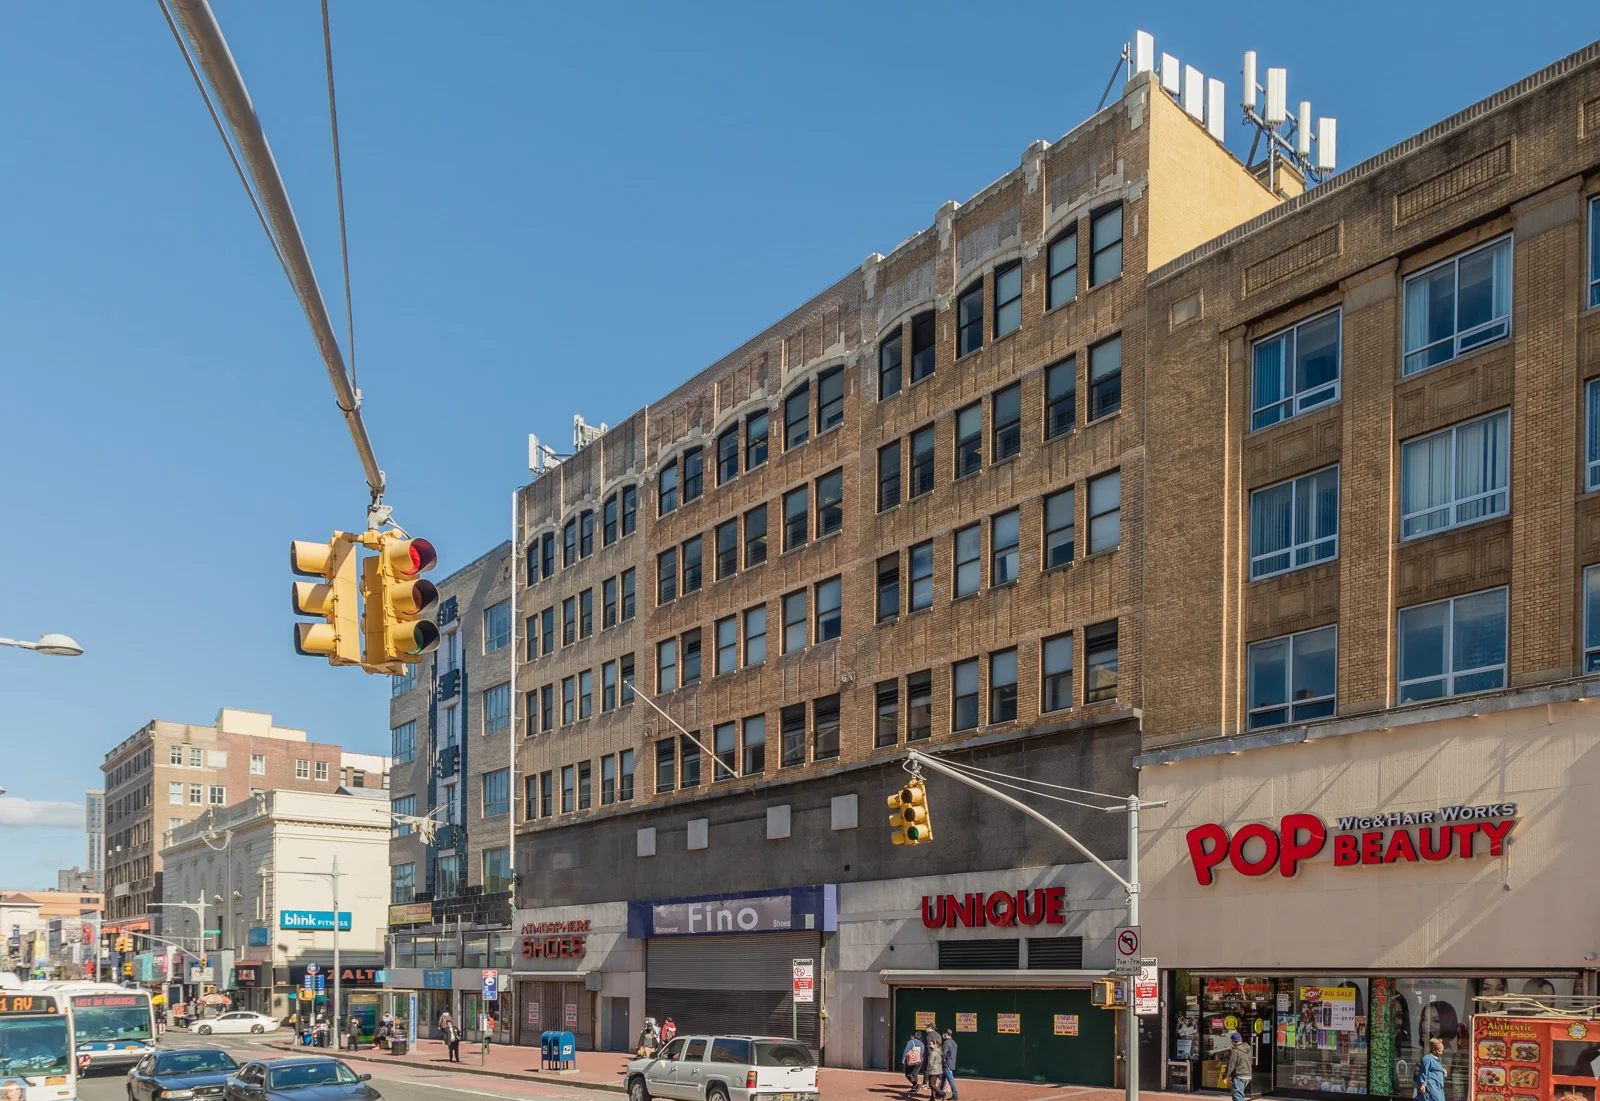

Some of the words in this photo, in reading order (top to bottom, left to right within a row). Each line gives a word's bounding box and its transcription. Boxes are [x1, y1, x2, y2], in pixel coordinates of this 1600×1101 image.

[1440, 803, 1516, 820] WORKS
[1186, 813, 1327, 886] POP
[1334, 820, 1515, 866] BEAUTY
[921, 887, 1067, 929] UNIQUE
[285, 913, 316, 926] blink
[688, 903, 758, 933] Fino
[772, 919, 791, 928] Shoes
[521, 920, 592, 934] ATMOSPHERE
[522, 936, 584, 958] SHOES
[1208, 979, 1237, 992] POP
[13, 997, 32, 1011] AV
